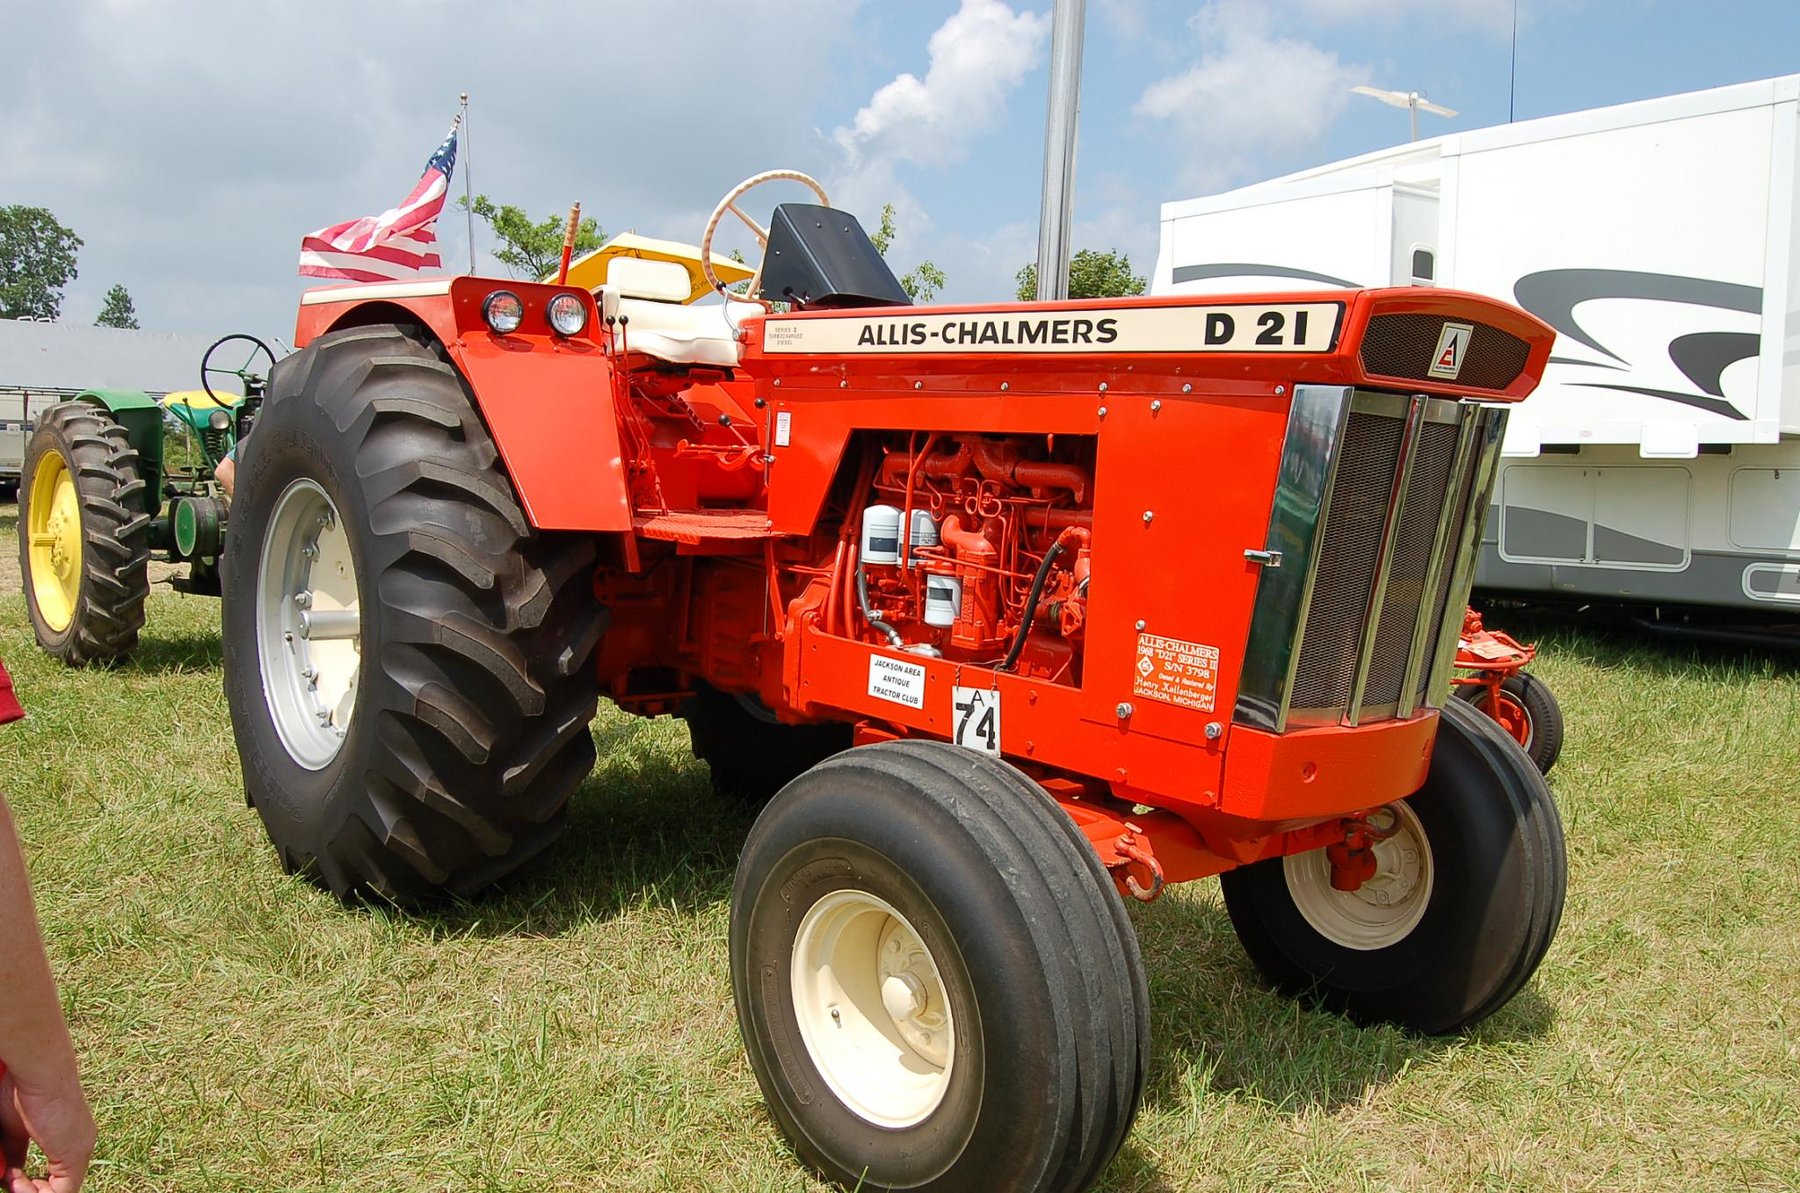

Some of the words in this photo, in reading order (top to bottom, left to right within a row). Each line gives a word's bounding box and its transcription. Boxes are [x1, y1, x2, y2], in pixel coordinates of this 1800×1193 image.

[857, 318, 1118, 346] ALLIS-CHALMERS
[1204, 312, 1235, 346] D
[1255, 311, 1308, 346] 21
[1137, 645, 1154, 657] 1968
[1177, 653, 1208, 668] SERIES
[1138, 636, 1218, 659] ALLIS-CHALMERS
[874, 659, 903, 673] JACKSON
[904, 666, 921, 677] AREA
[1164, 661, 1184, 673] S/N
[1186, 666, 1210, 679] 3798
[882, 675, 910, 688] ANTIQUE
[1135, 675, 1159, 690] Henry
[873, 686, 901, 700] TRACTOR
[901, 694, 919, 705] CLUB
[970, 690, 985, 707] A
[1173, 695, 1213, 711] MICHIGAN
[955, 702, 996, 750] 74
